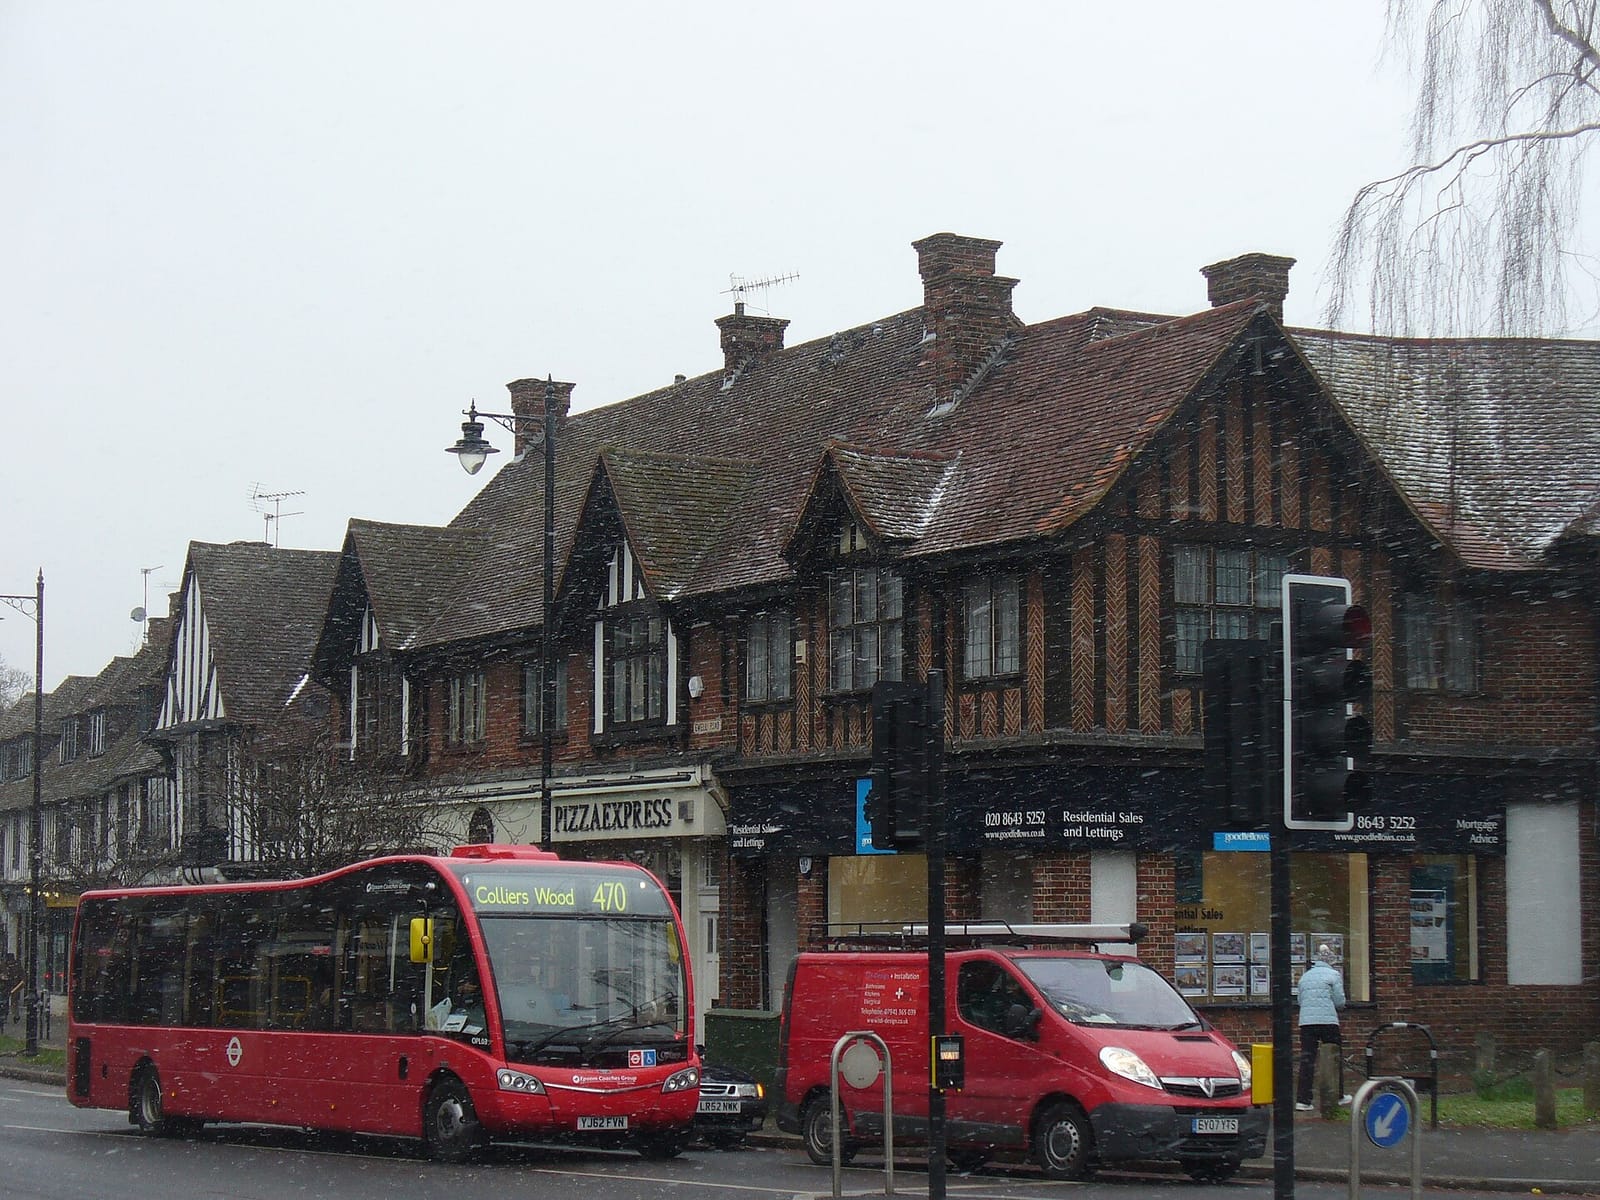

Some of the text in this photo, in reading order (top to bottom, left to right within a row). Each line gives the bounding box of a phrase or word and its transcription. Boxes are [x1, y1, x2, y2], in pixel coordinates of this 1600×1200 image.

[554, 799, 672, 833] PIZZAEXPRESS
[985, 810, 1046, 827] 020 8643 5252
[1063, 810, 1144, 824] Residential Sales
[732, 824, 760, 835] Residential
[1357, 816, 1416, 830] 8643 5252
[1456, 819, 1499, 832] Mortgage
[1063, 826, 1124, 842] and Lettings
[1224, 832, 1270, 844] goodfellows
[1334, 832, 1416, 843] www.goodfellows.co.uk
[1469, 833, 1499, 844] Advice
[732, 838, 765, 850] and Lettings
[475, 882, 627, 912] Colliers Wood 470
[1201, 907, 1224, 920] Sales
[699, 1102, 738, 1112] LR52 NWK
[581, 1116, 625, 1129] YJ62 FVN
